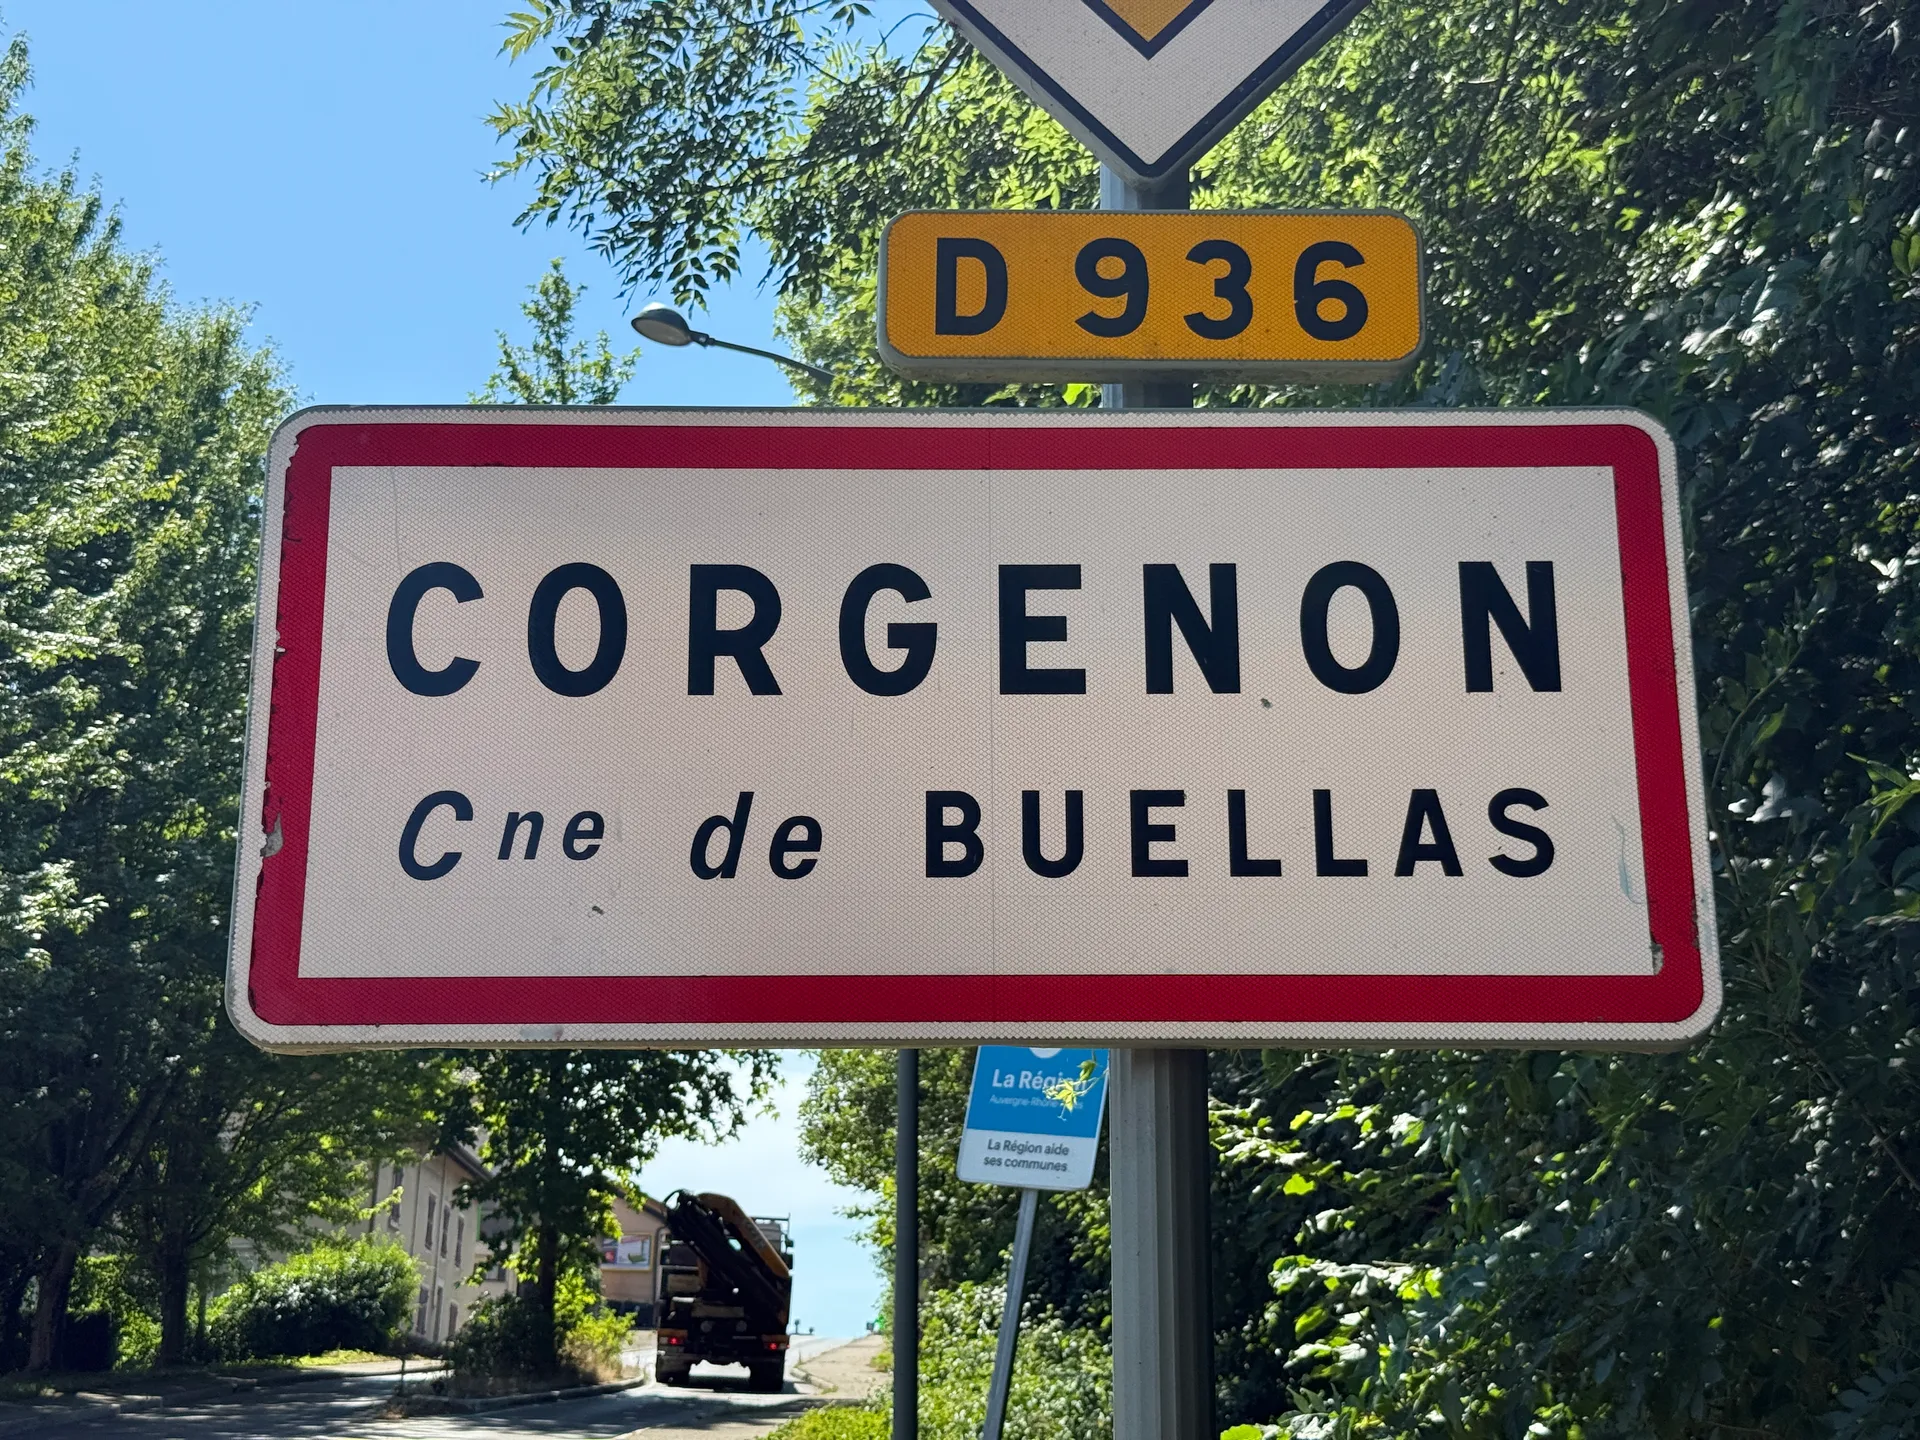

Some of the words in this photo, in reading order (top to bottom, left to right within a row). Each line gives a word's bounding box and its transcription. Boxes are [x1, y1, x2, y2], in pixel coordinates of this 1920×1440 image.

[935, 237, 1009, 337] D
[1074, 237, 1369, 342] 936
[386, 560, 1562, 698] CORGENON
[398, 790, 605, 881] Cne
[689, 790, 823, 881] de
[925, 786, 1556, 880] BUELLAS
[991, 1068, 1015, 1089] La
[983, 1156, 1003, 1167] ses
[1005, 1157, 1068, 1172] communes
[987, 1138, 1000, 1151] La
[1003, 1140, 1043, 1155] Région
[1044, 1143, 1070, 1156] aide
